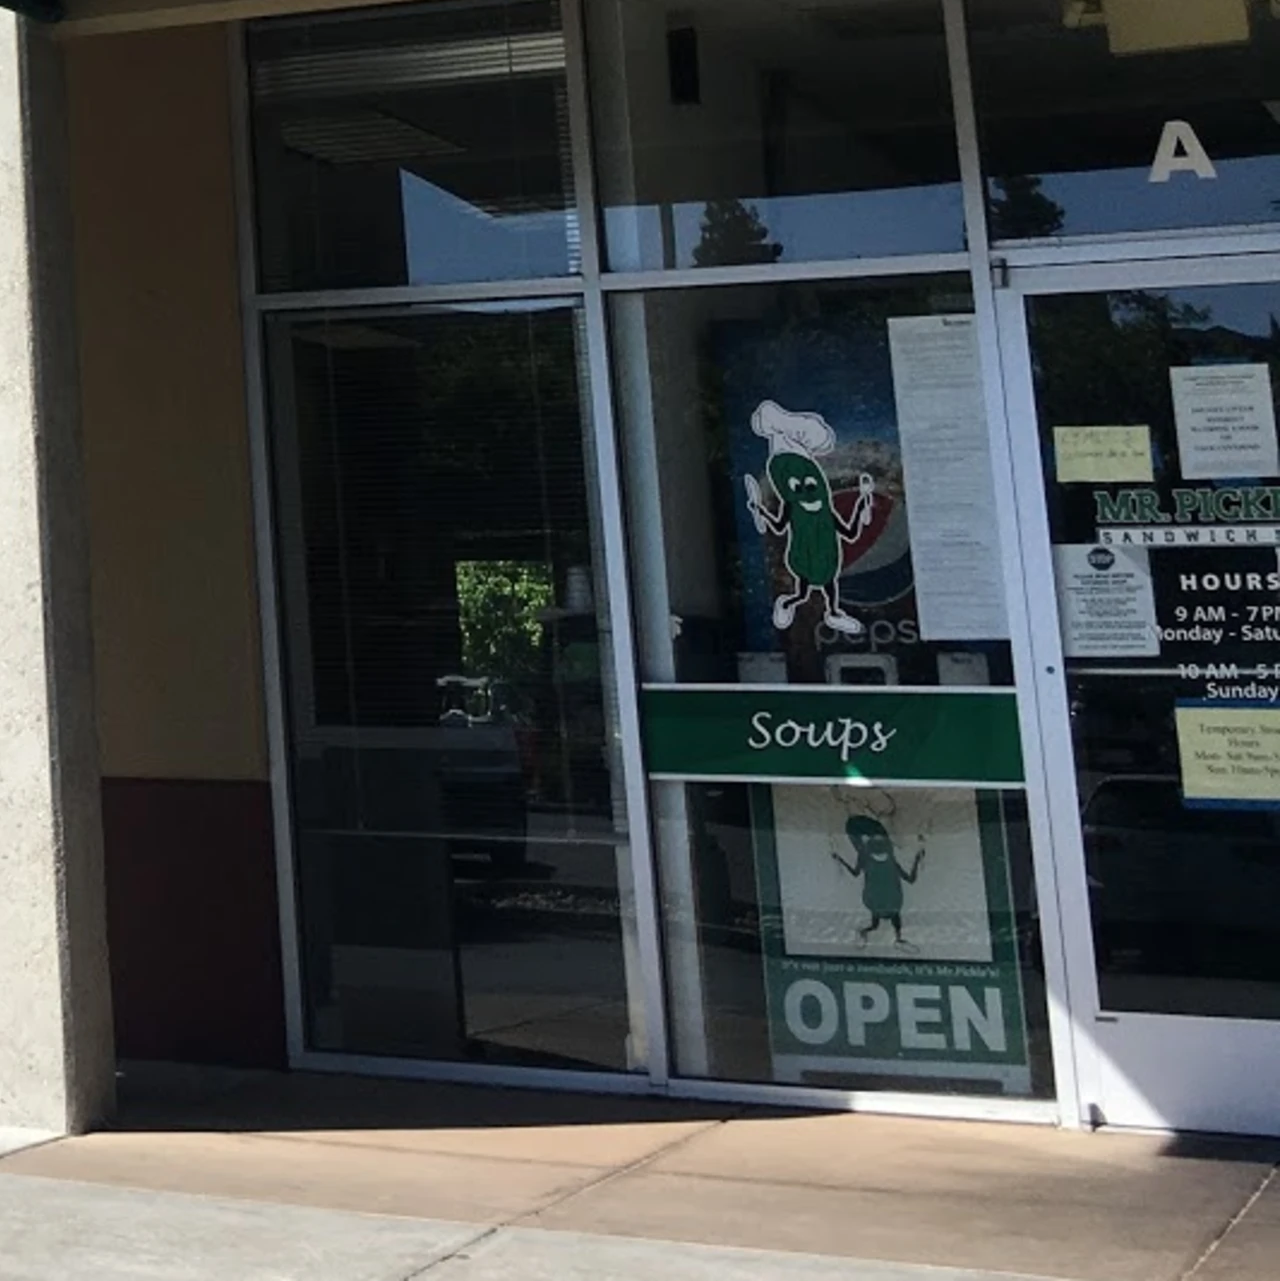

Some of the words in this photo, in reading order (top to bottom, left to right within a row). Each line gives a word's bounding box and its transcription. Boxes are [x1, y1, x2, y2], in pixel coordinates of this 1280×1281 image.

[1148, 119, 1218, 183] A
[1093, 488, 1172, 524] MR.
[1180, 572, 1280, 591] HOURS
[1175, 606, 1188, 622] 9
[1193, 605, 1226, 622] AM
[1246, 606, 1259, 622] 7
[1154, 624, 1224, 645] onday
[1206, 681, 1279, 703] Sunday
[748, 711, 897, 761] Soups
[783, 978, 1007, 1052] OPEN
